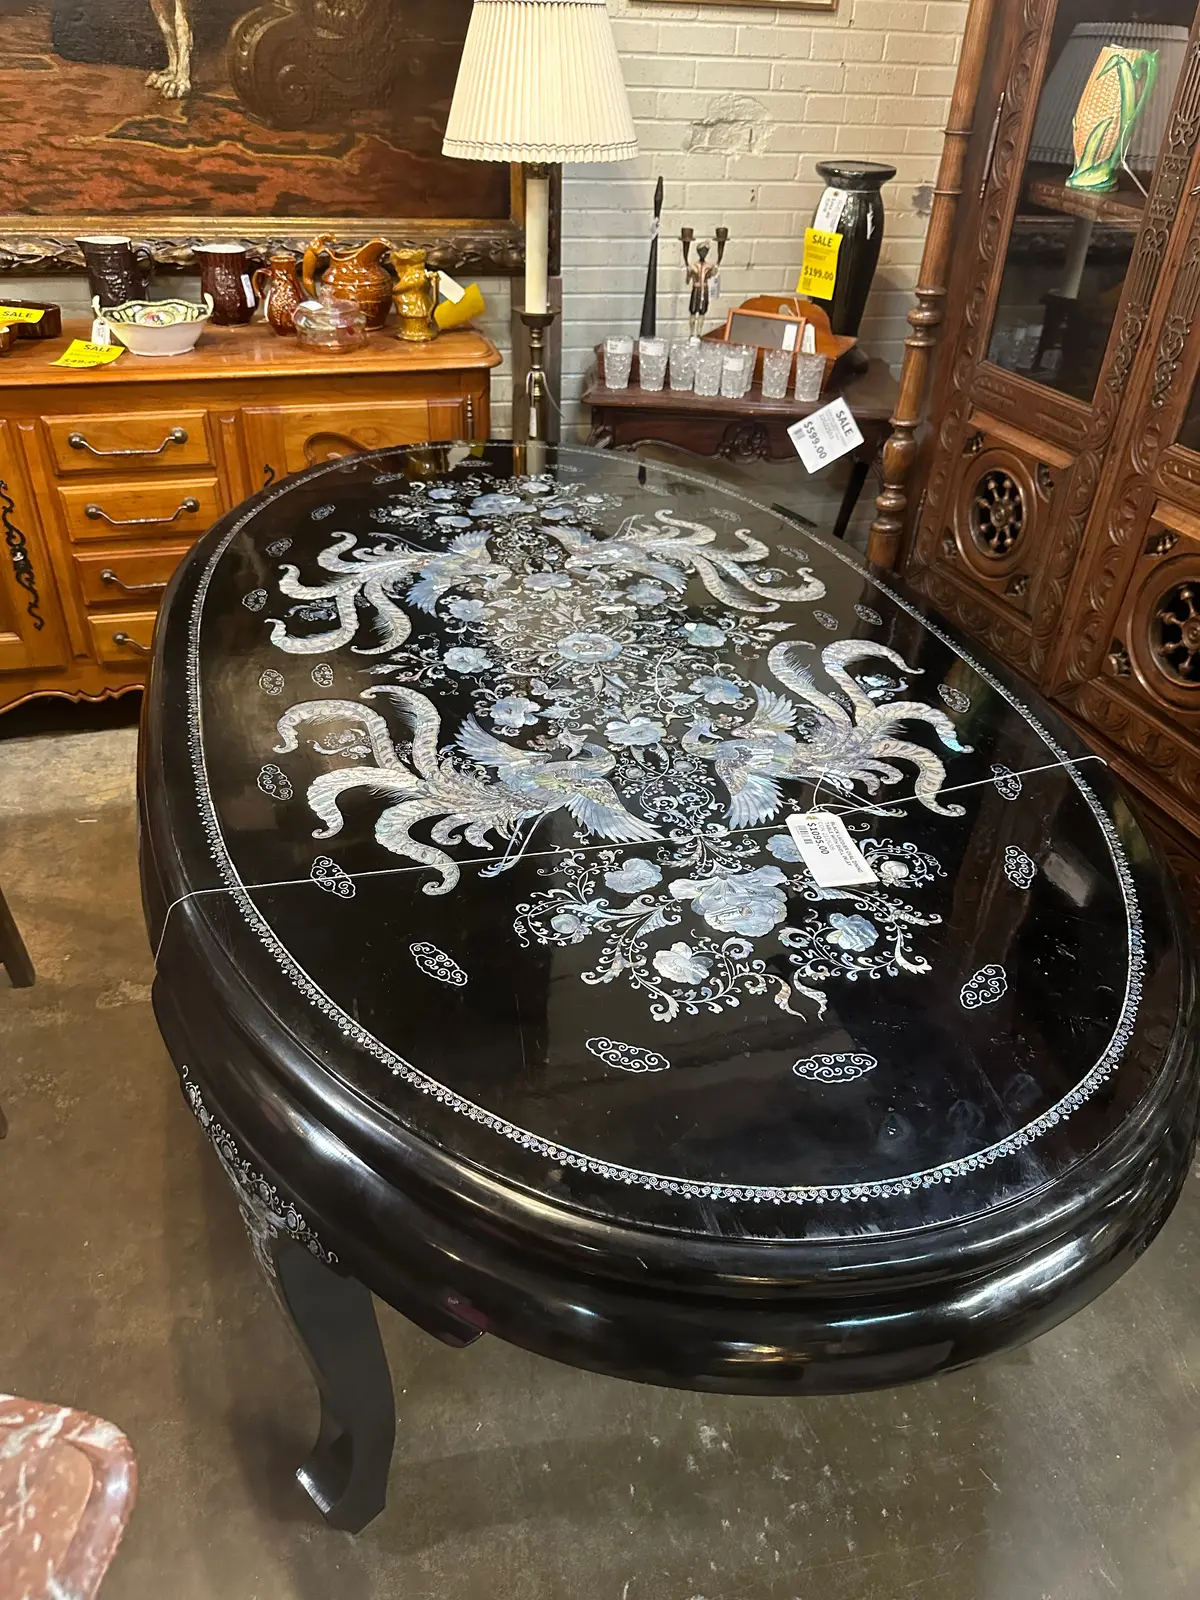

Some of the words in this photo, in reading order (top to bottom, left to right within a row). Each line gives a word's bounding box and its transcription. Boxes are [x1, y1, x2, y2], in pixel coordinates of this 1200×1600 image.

[812, 234, 832, 248] SALE
[804, 265, 834, 281] $199.00
[83, 344, 113, 353] SALE
[835, 410, 854, 437] SALE
[803, 421, 827, 459] $599.00
[807, 822, 830, 855] $1095.00
